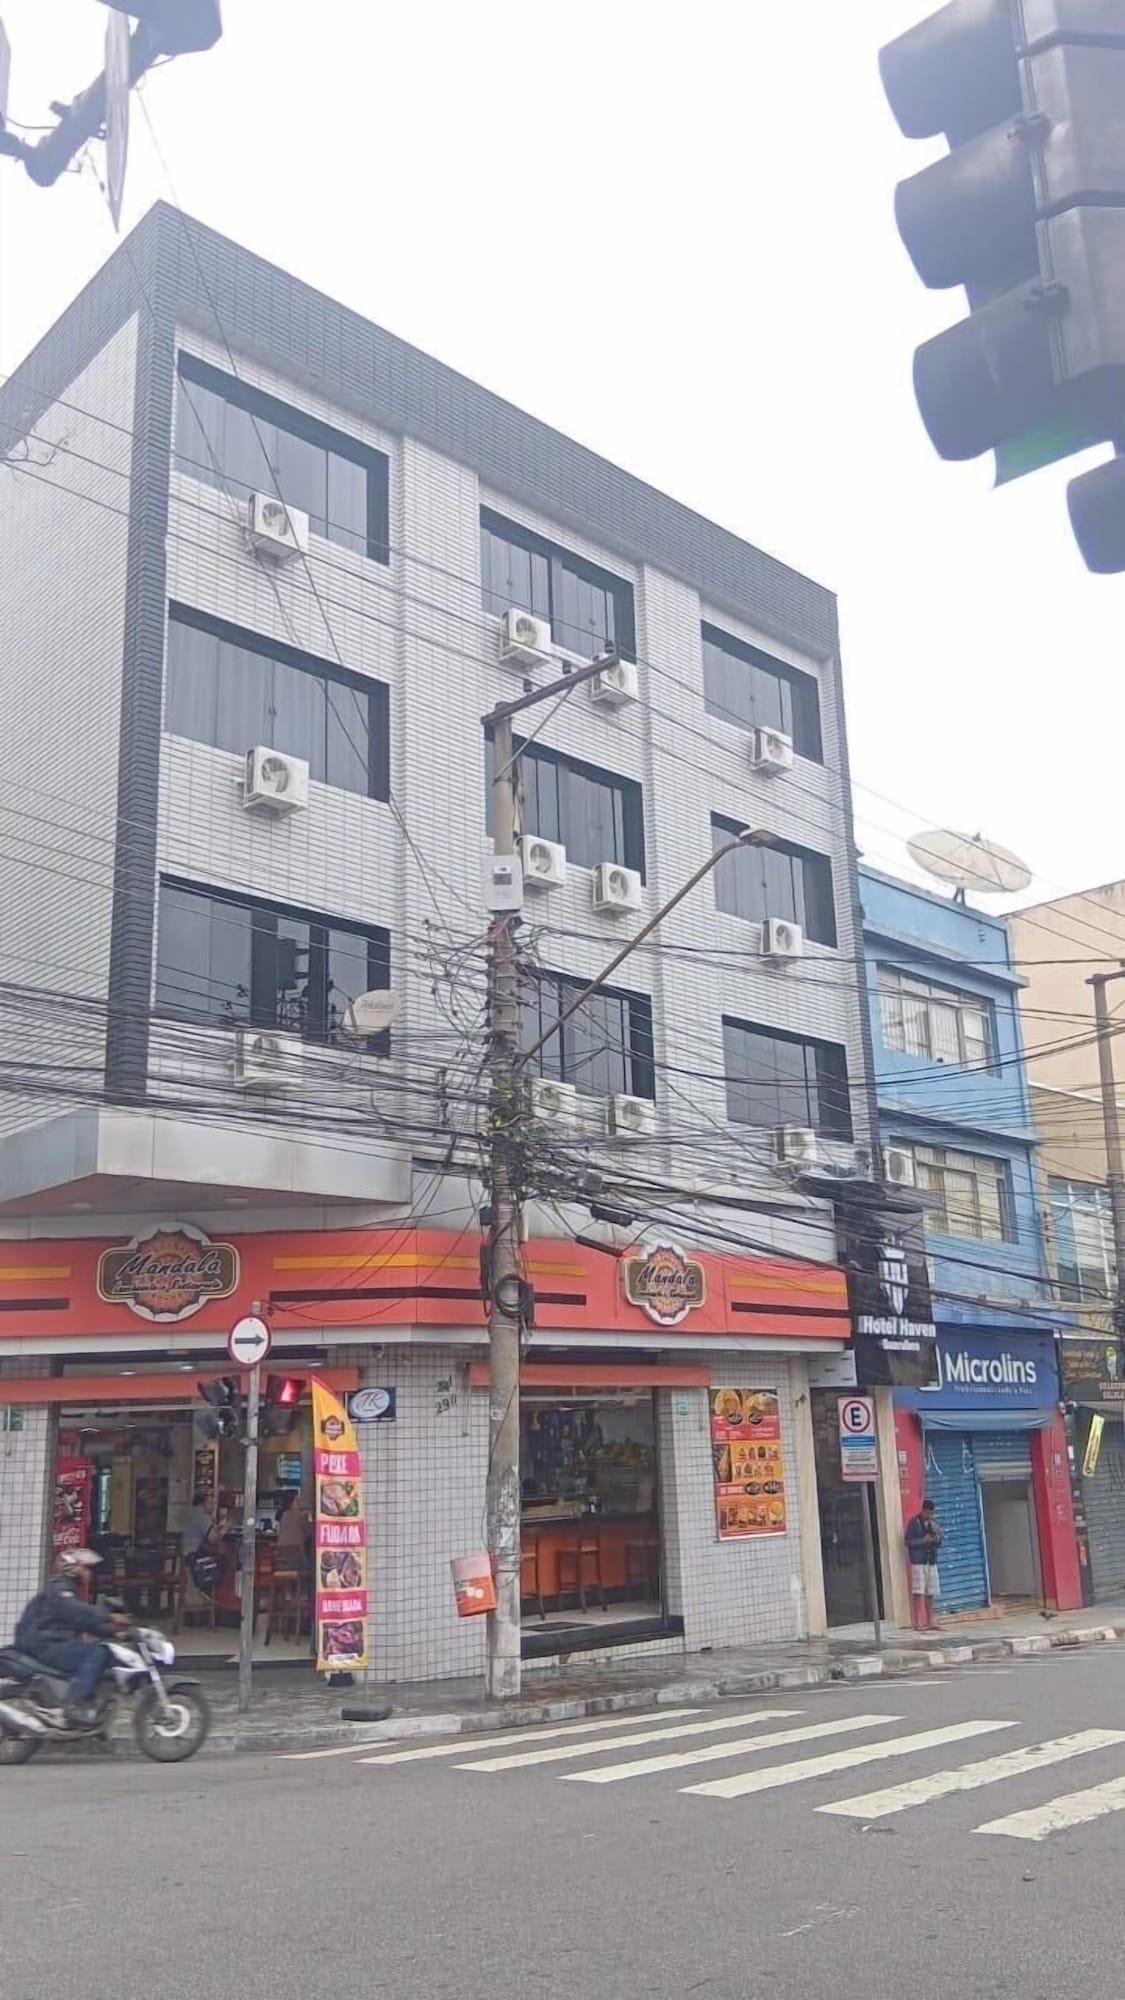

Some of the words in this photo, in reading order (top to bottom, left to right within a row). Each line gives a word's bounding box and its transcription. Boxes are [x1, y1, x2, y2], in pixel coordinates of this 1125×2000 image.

[114, 1250, 222, 1280] Mandala
[635, 1264, 697, 1287] Mandala
[861, 1315, 898, 1336] Hotel
[900, 1319, 937, 1339] Haven
[944, 1351, 1037, 1384] Microlins
[850, 1407, 862, 1427] E
